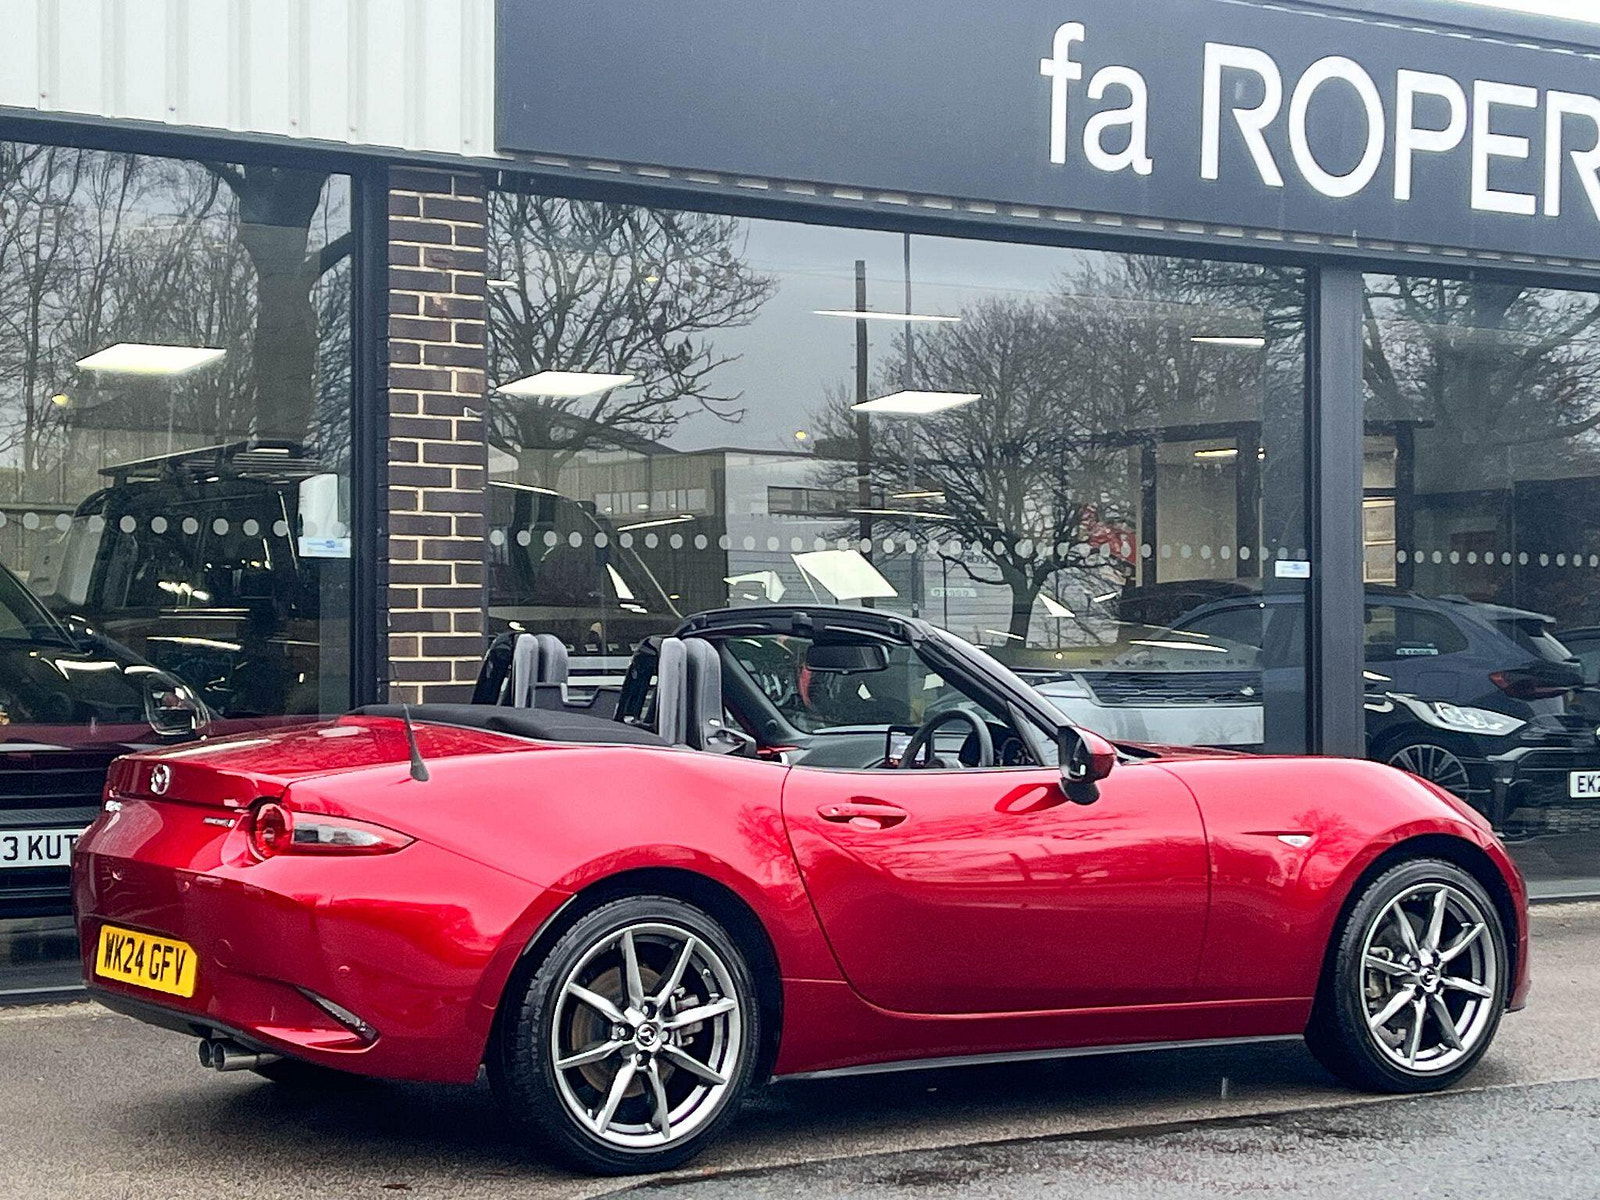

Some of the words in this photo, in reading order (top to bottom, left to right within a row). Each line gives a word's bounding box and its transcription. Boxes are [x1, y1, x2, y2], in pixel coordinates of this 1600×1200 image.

[1040, 21, 1153, 176] fa
[1200, 41, 1600, 221] ROPER
[1577, 775, 1600, 793] EK
[28, 834, 78, 860] KUT
[104, 932, 145, 977] WK24
[149, 943, 187, 986] GFV
